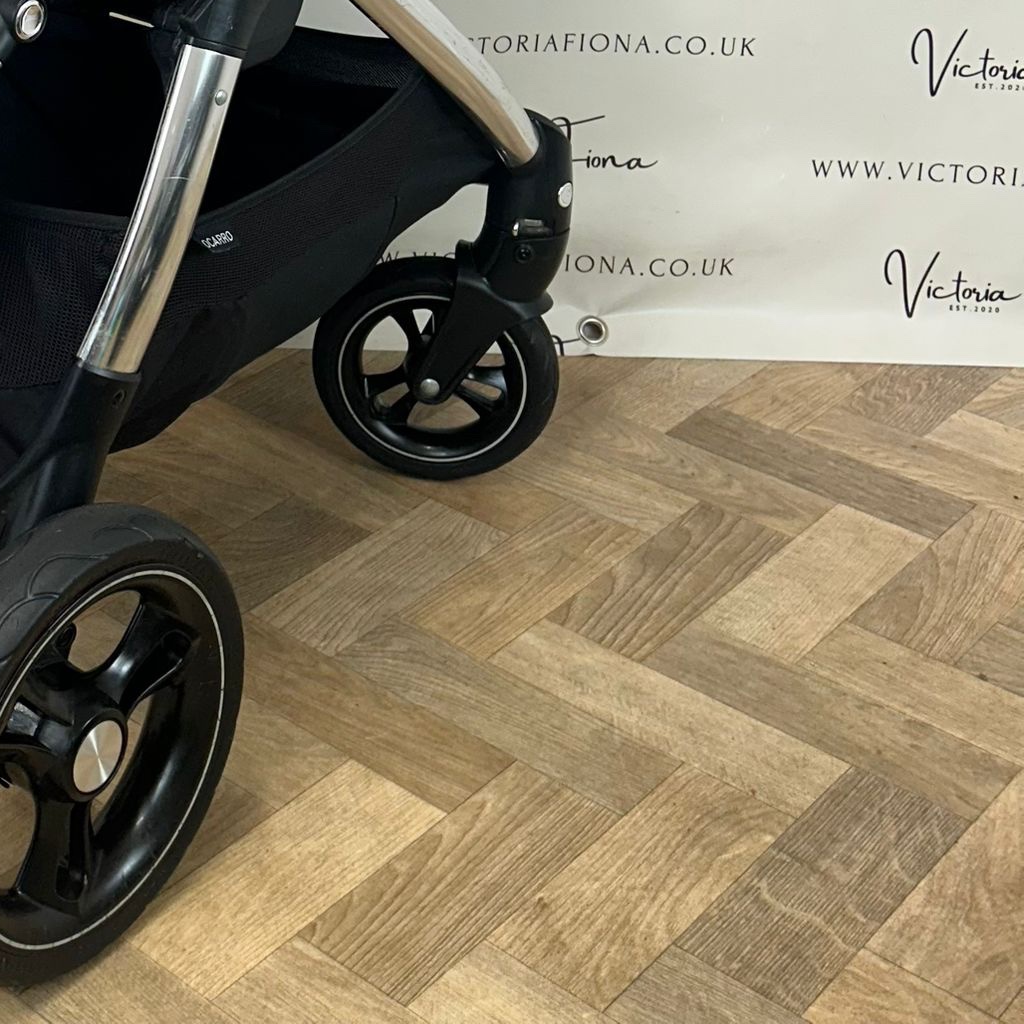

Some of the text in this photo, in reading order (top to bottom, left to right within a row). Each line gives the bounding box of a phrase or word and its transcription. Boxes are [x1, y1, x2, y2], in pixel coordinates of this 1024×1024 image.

[469, 33, 756, 57] TORIAFIONA.CO.UK
[812, 160, 1024, 187] WWW.VICTORI
[884, 249, 1023, 319] Victoria
[949, 305, 1000, 313] EST.2020
